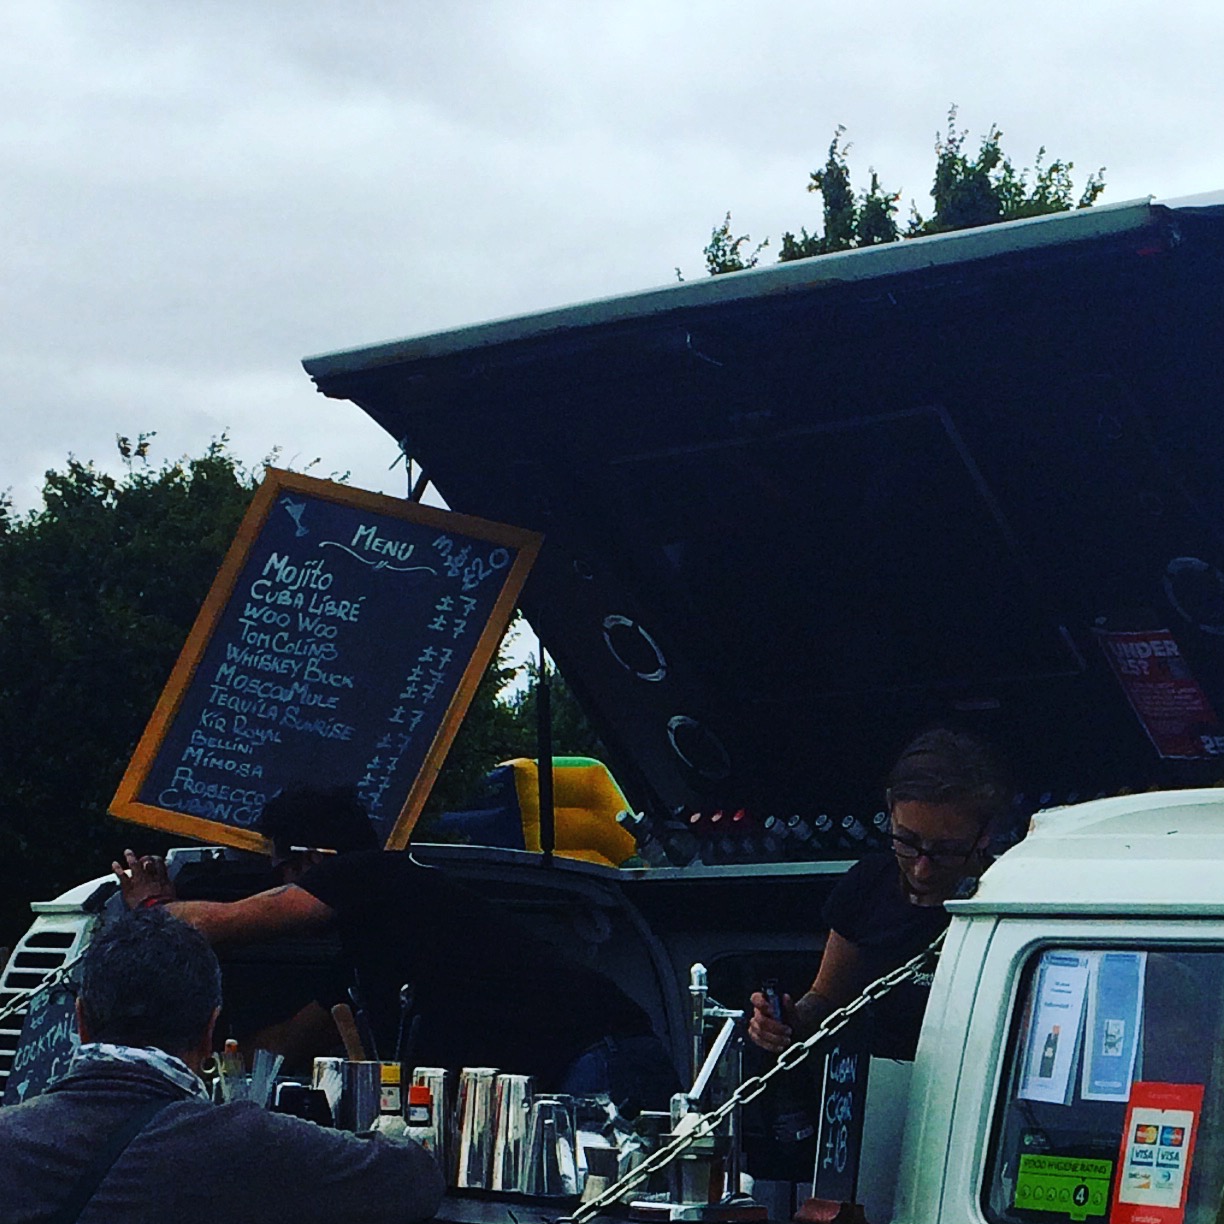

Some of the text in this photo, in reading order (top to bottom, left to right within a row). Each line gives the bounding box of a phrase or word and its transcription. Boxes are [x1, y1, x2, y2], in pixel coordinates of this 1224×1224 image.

[352, 524, 416, 561] MENU
[250, 579, 304, 609] CUBA
[1108, 640, 1180, 659] UNDER
[1135, 1148, 1180, 1162] VISA VISA
[1075, 1187, 1086, 1203] 4
